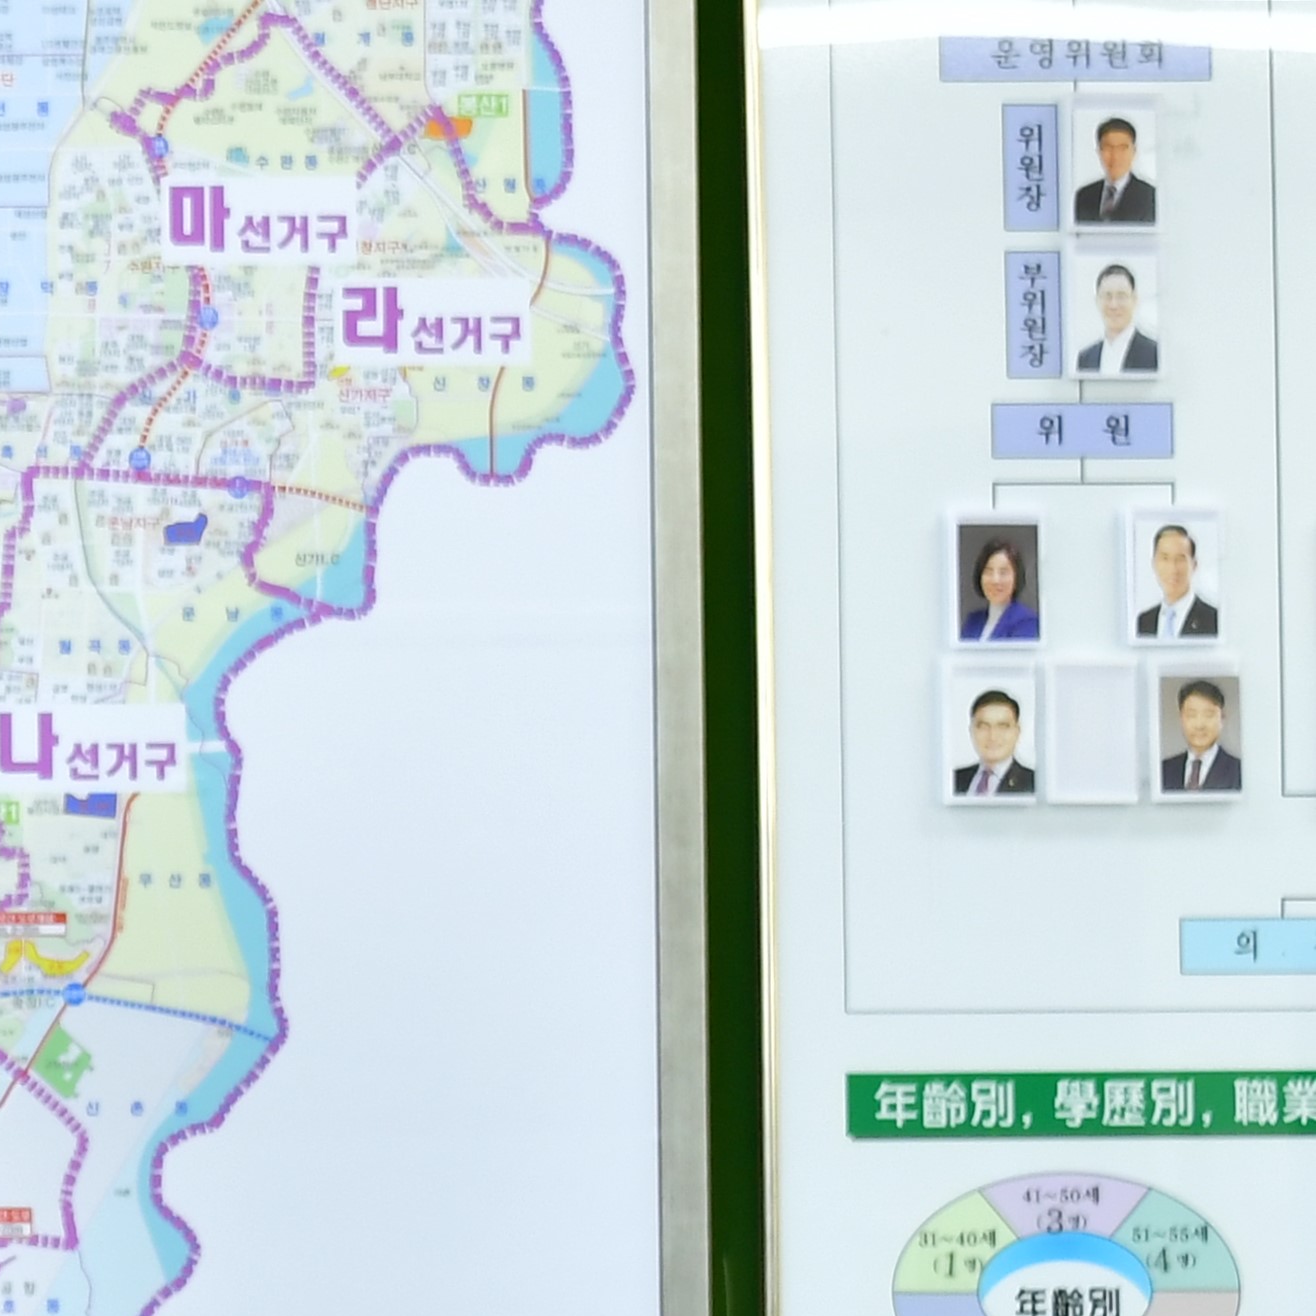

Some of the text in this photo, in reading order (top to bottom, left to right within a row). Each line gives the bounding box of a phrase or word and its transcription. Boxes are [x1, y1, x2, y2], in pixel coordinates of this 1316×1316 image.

[1017, 123, 1044, 212] 위원장
[1017, 263, 1049, 368] 부위원장
[1036, 414, 1132, 446] 위원
